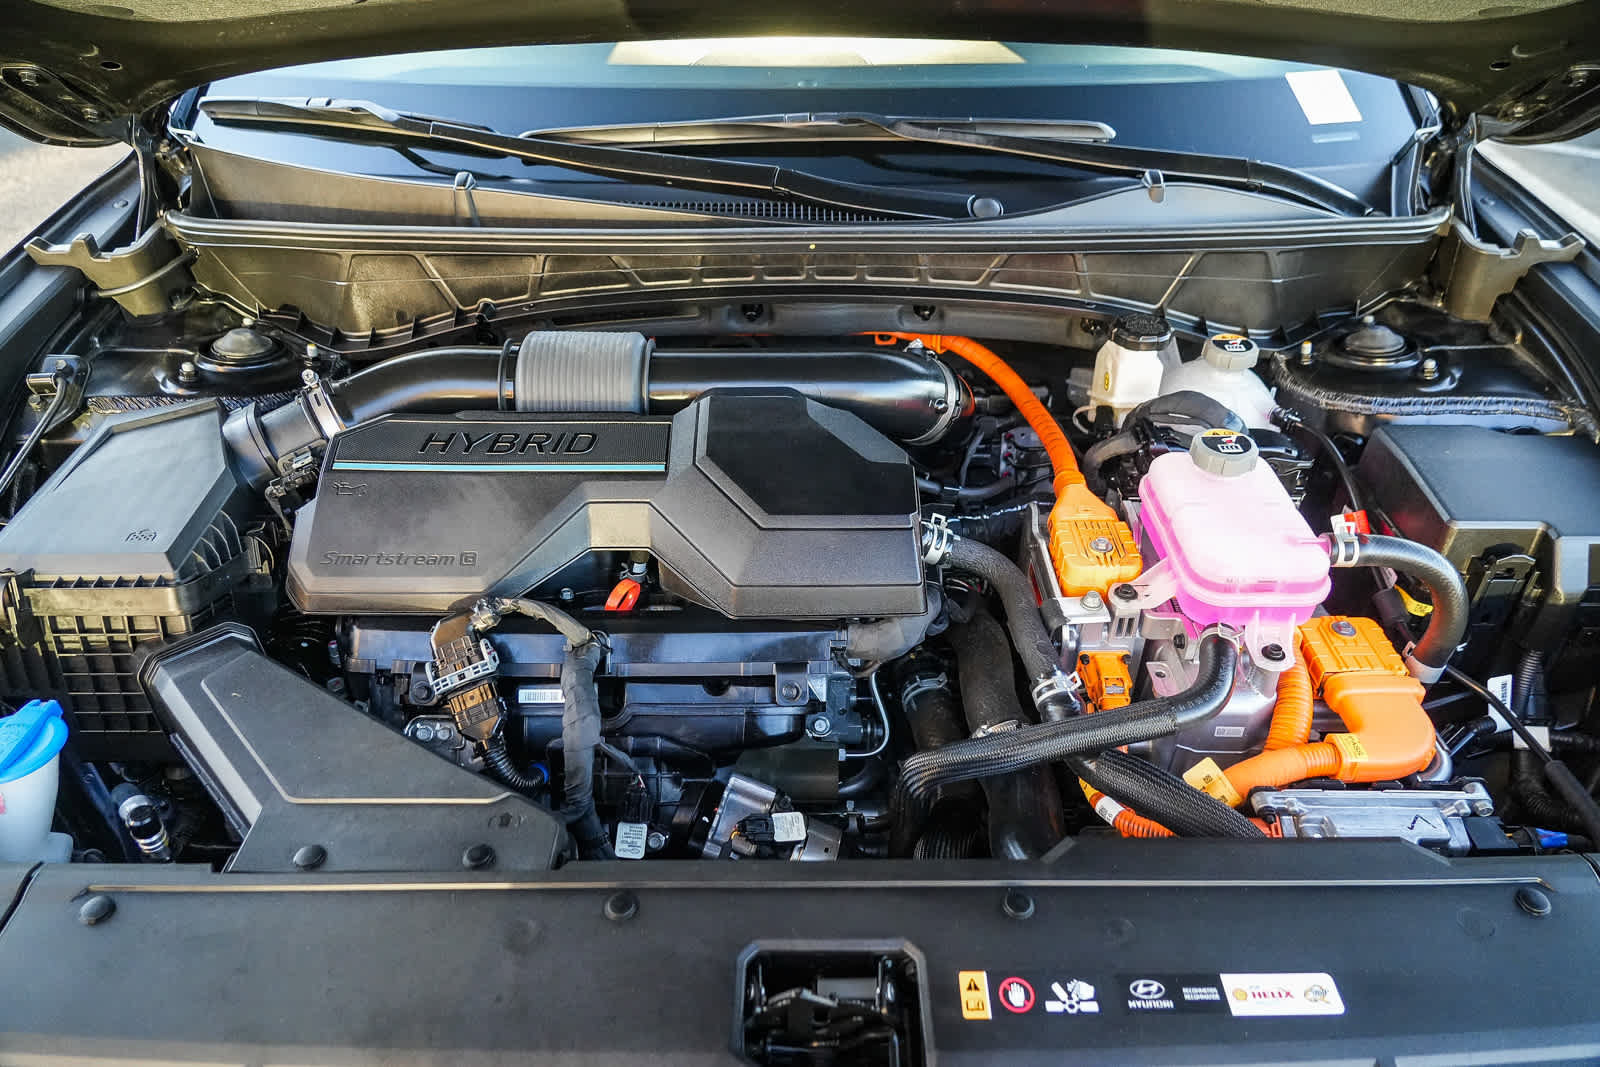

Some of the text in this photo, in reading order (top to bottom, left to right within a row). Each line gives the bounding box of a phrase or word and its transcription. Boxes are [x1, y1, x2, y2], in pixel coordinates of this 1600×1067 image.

[418, 432, 599, 454] HYBRID
[320, 551, 456, 566] Smartstream
[1128, 1000, 1174, 1009] HYUNDAI
